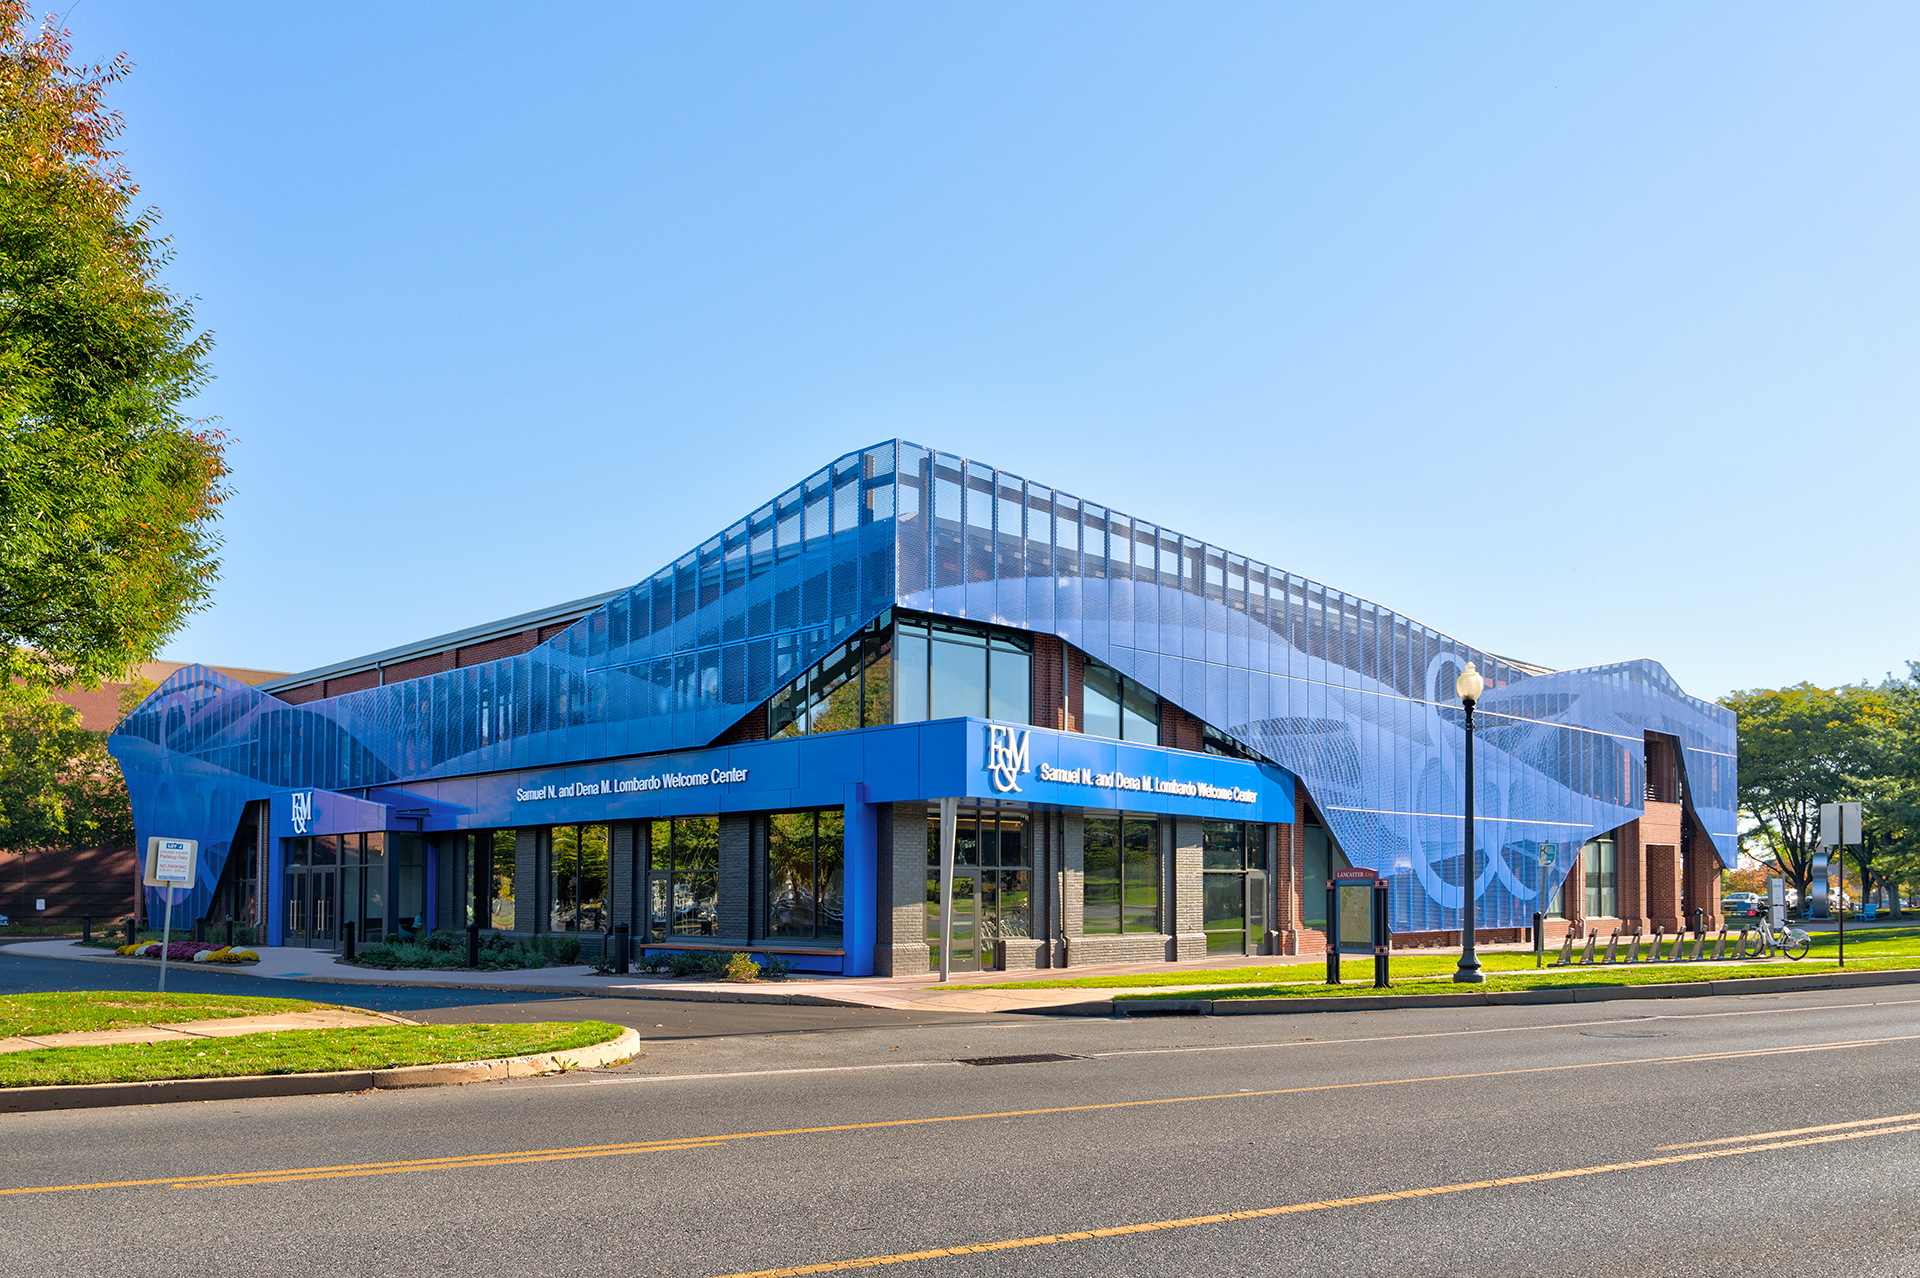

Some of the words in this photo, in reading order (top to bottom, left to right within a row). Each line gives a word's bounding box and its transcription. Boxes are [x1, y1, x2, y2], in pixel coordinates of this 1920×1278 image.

[516, 785, 546, 802] Samuel
[548, 784, 557, 799] N.
[558, 782, 575, 797] and
[576, 782, 599, 796] Dena
[601, 779, 612, 794] M.
[614, 774, 661, 793] Lombardo
[662, 772, 709, 789] Welcome
[711, 767, 748, 784] Center
[1040, 762, 1080, 783] Samuel
[1081, 768, 1093, 785] N.
[1095, 771, 1113, 787] and
[1115, 772, 1140, 790] Dena
[1142, 775, 1153, 791] M.
[1155, 776, 1196, 796] Lombardo
[1197, 781, 1232, 800] Welcome
[1233, 786, 1257, 803] Center
